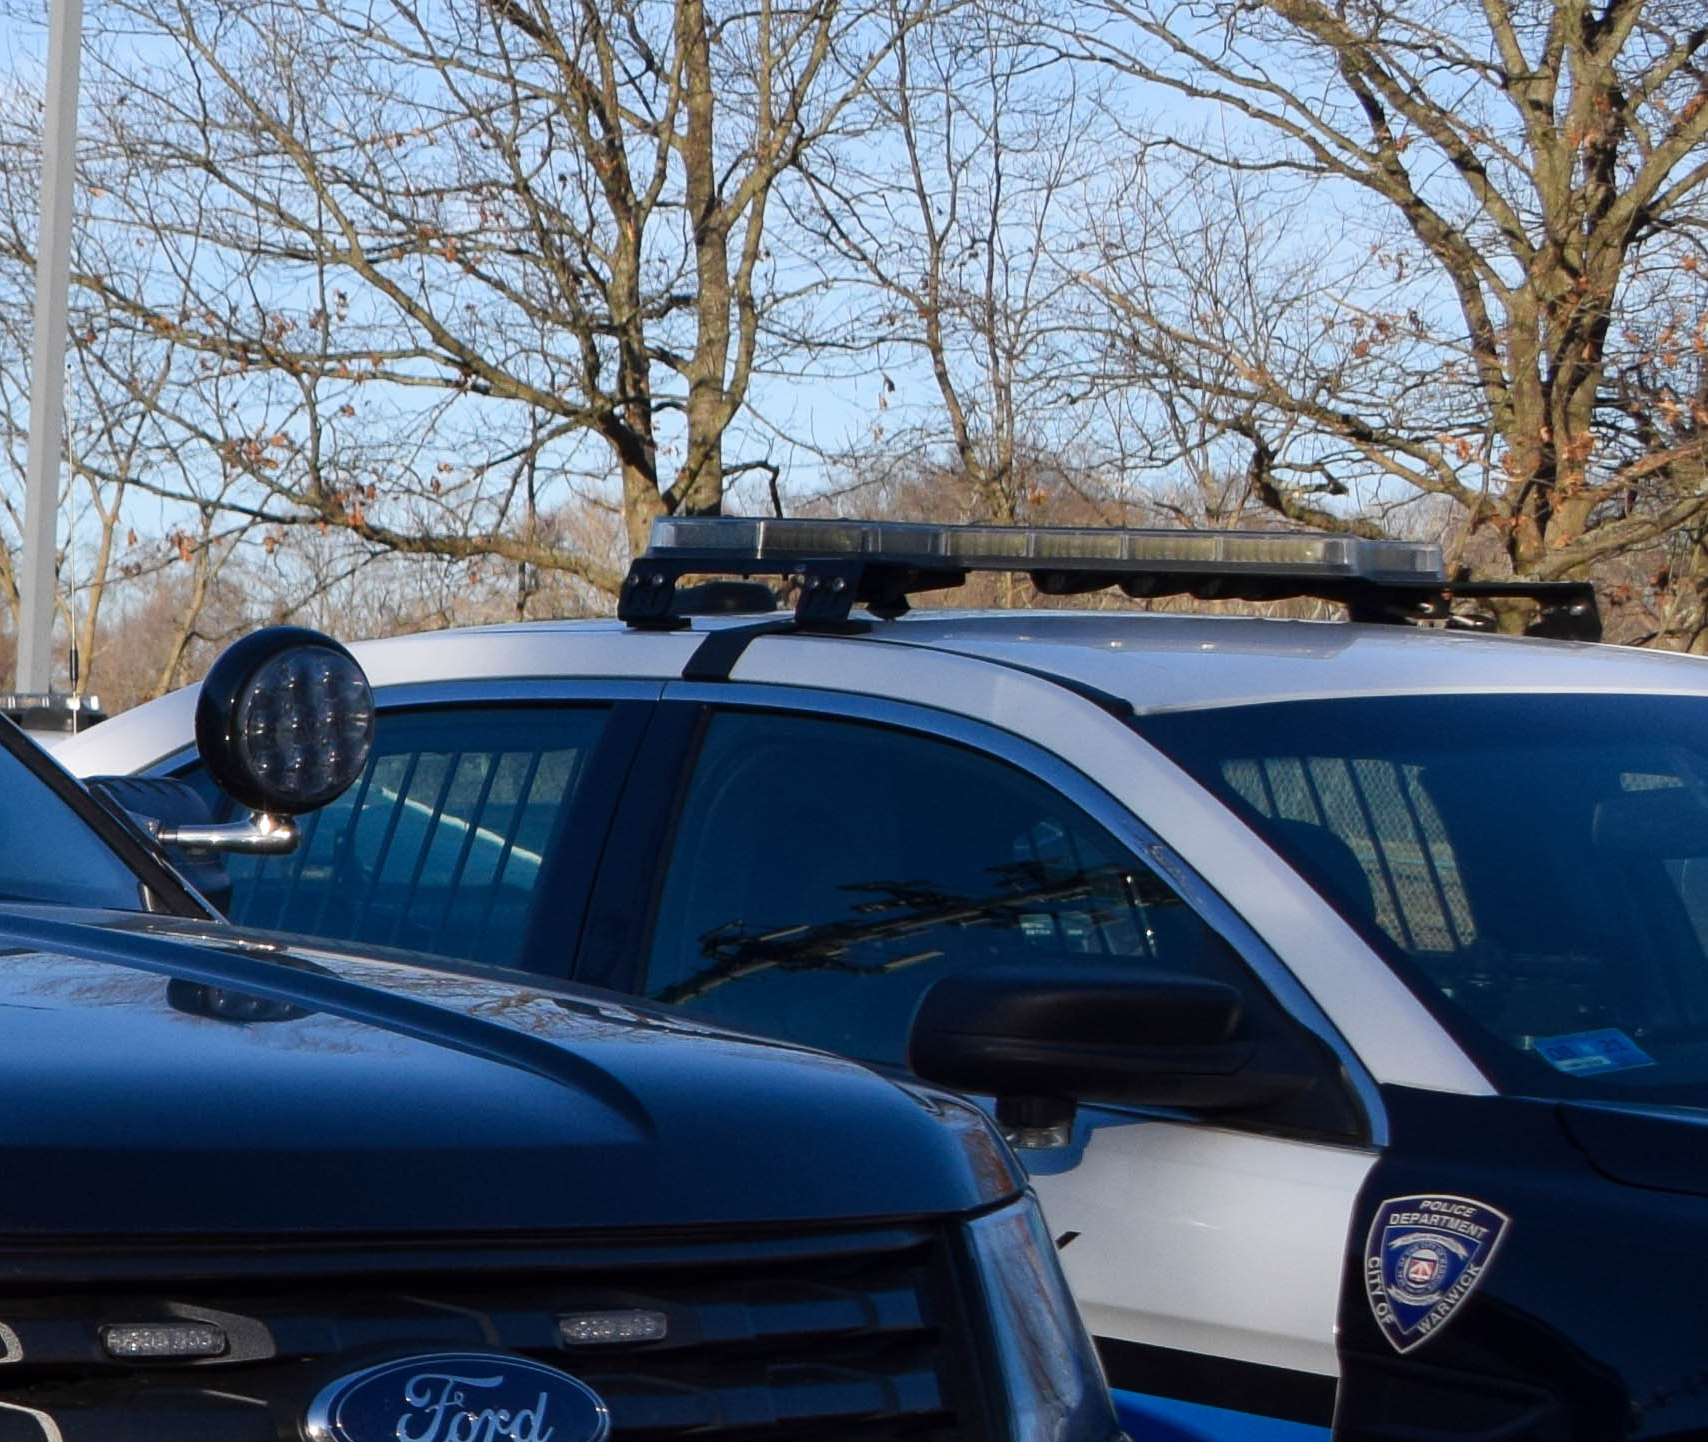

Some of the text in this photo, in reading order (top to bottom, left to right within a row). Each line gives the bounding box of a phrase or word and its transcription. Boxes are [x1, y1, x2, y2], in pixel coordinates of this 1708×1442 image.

[1390, 1213, 1489, 1239] DEPARTMENT
[1419, 1200, 1476, 1217] POLICE
[1367, 1256, 1396, 1324] CITY OF
[1417, 1264, 1482, 1334] WARWICK
